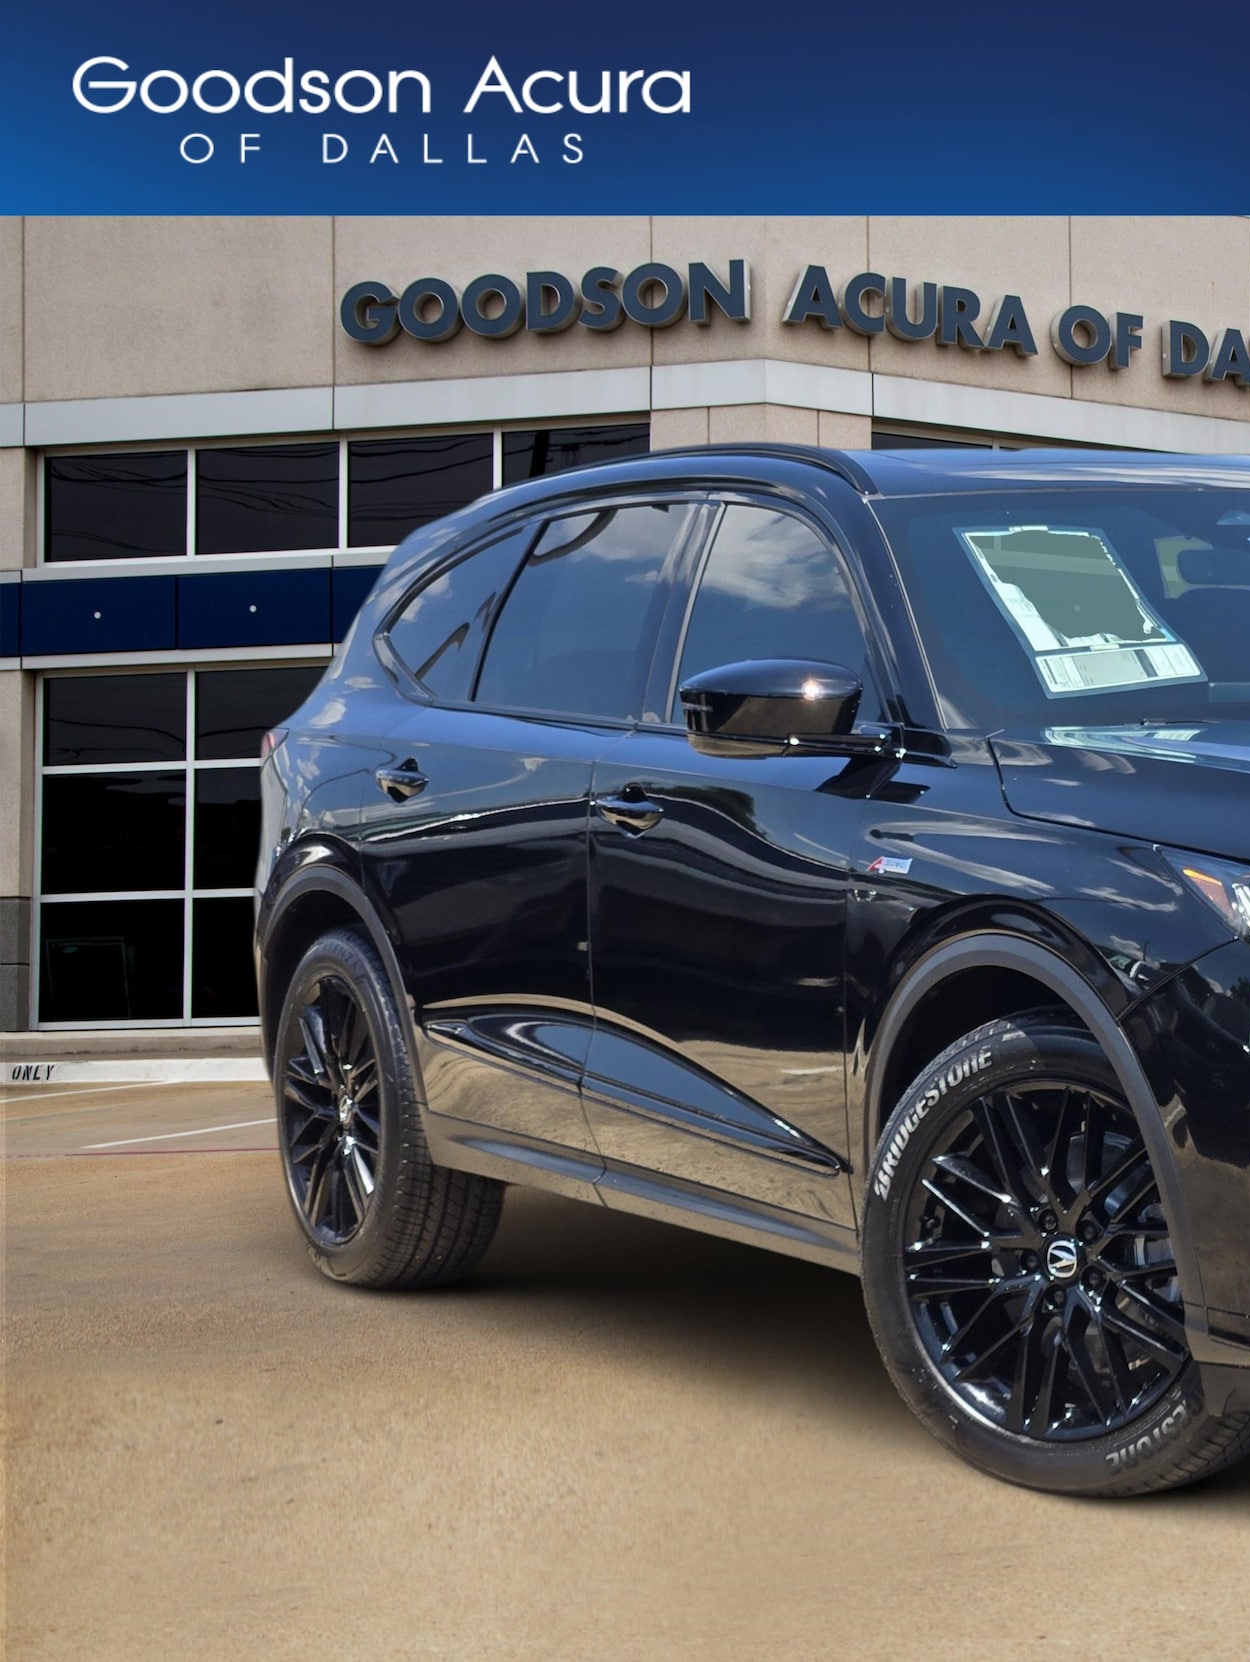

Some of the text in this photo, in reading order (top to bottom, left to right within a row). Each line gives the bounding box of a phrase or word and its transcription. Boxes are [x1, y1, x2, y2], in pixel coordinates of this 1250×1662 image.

[340, 258, 751, 348] GOODSON
[783, 265, 1038, 357] ACURA
[1051, 305, 1144, 368] OF
[11, 1064, 55, 1081] ONLY
[873, 1046, 993, 1201] BRIDGESTONE
